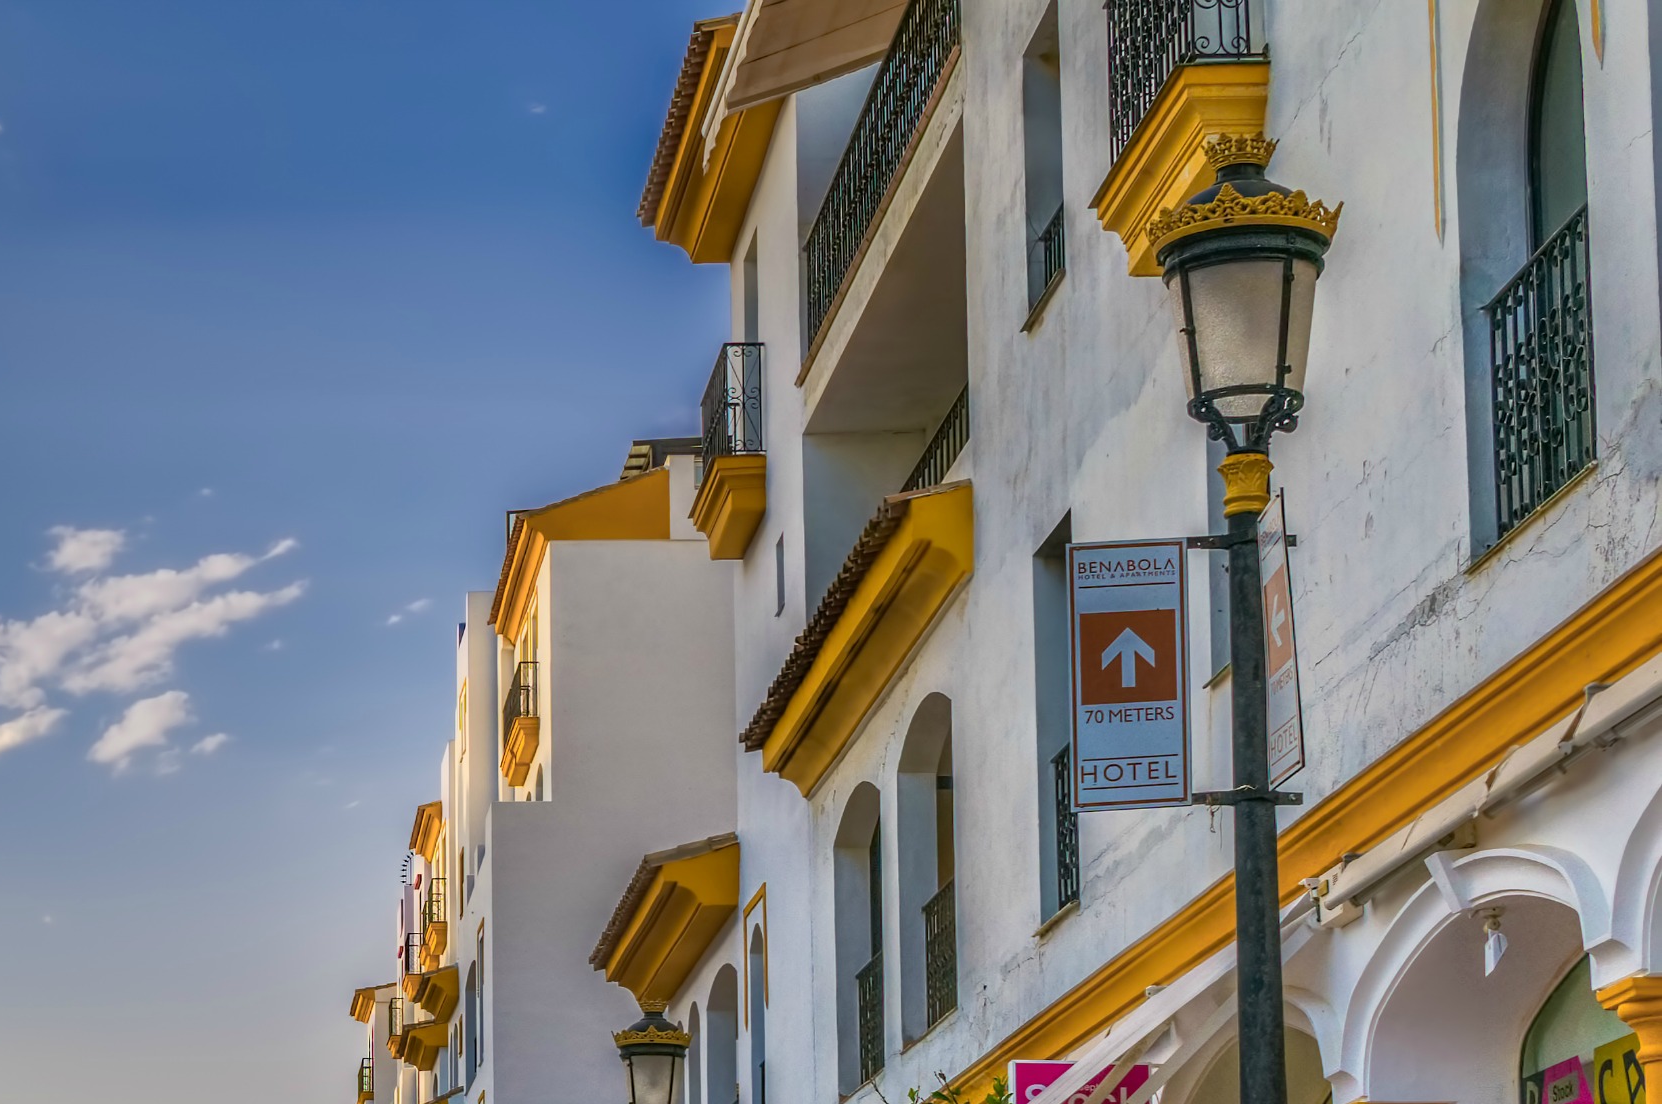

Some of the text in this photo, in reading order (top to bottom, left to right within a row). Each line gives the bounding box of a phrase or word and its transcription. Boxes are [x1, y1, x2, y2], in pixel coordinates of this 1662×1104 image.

[1078, 558, 1176, 574] BENABOLA
[1119, 570, 1176, 579] APARTMENTS
[1084, 706, 1175, 725] 70 METERS
[1270, 720, 1298, 758] HOTEL
[1080, 760, 1178, 784] HOTEL
[1551, 1080, 1574, 1102] Stock
